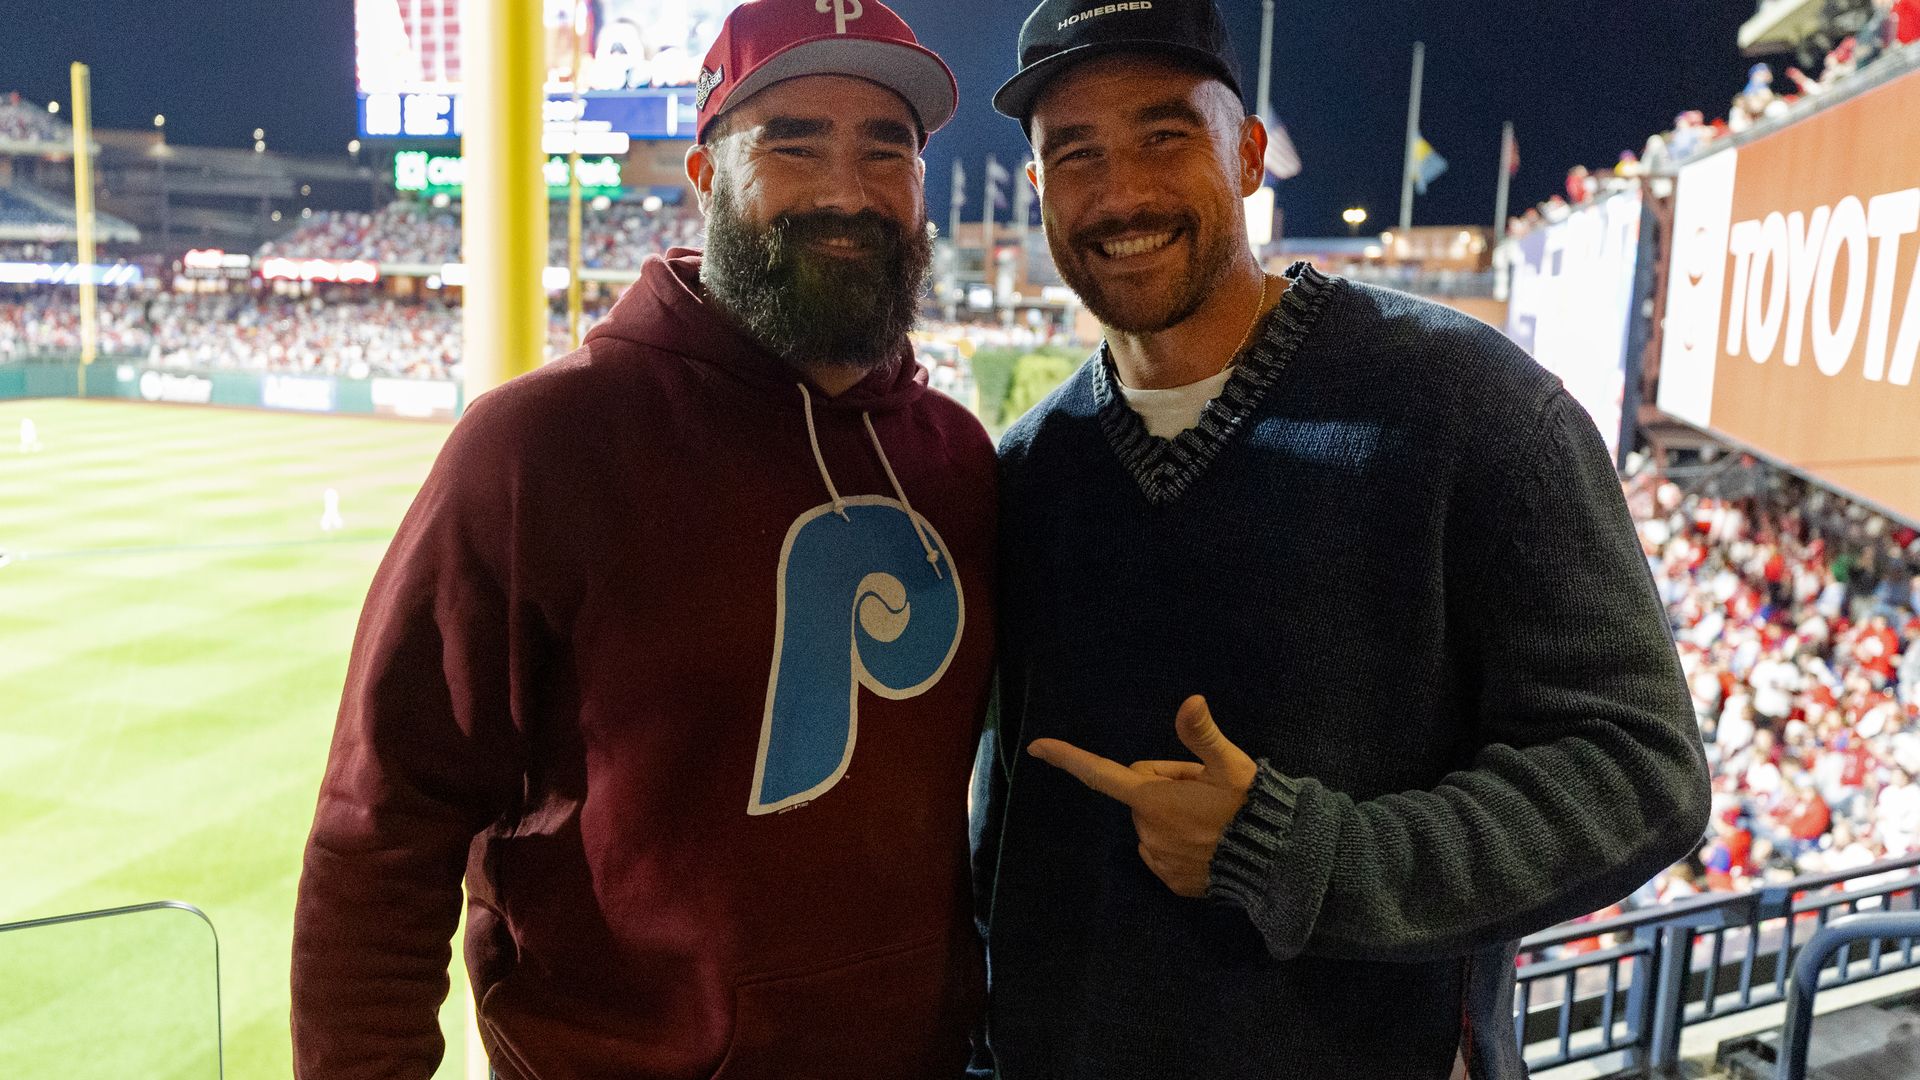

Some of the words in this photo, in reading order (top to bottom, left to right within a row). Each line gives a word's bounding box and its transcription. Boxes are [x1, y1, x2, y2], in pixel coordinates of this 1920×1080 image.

[815, 0, 863, 34] P
[1057, 1, 1153, 31] HOMEBRED
[747, 494, 965, 816] P
